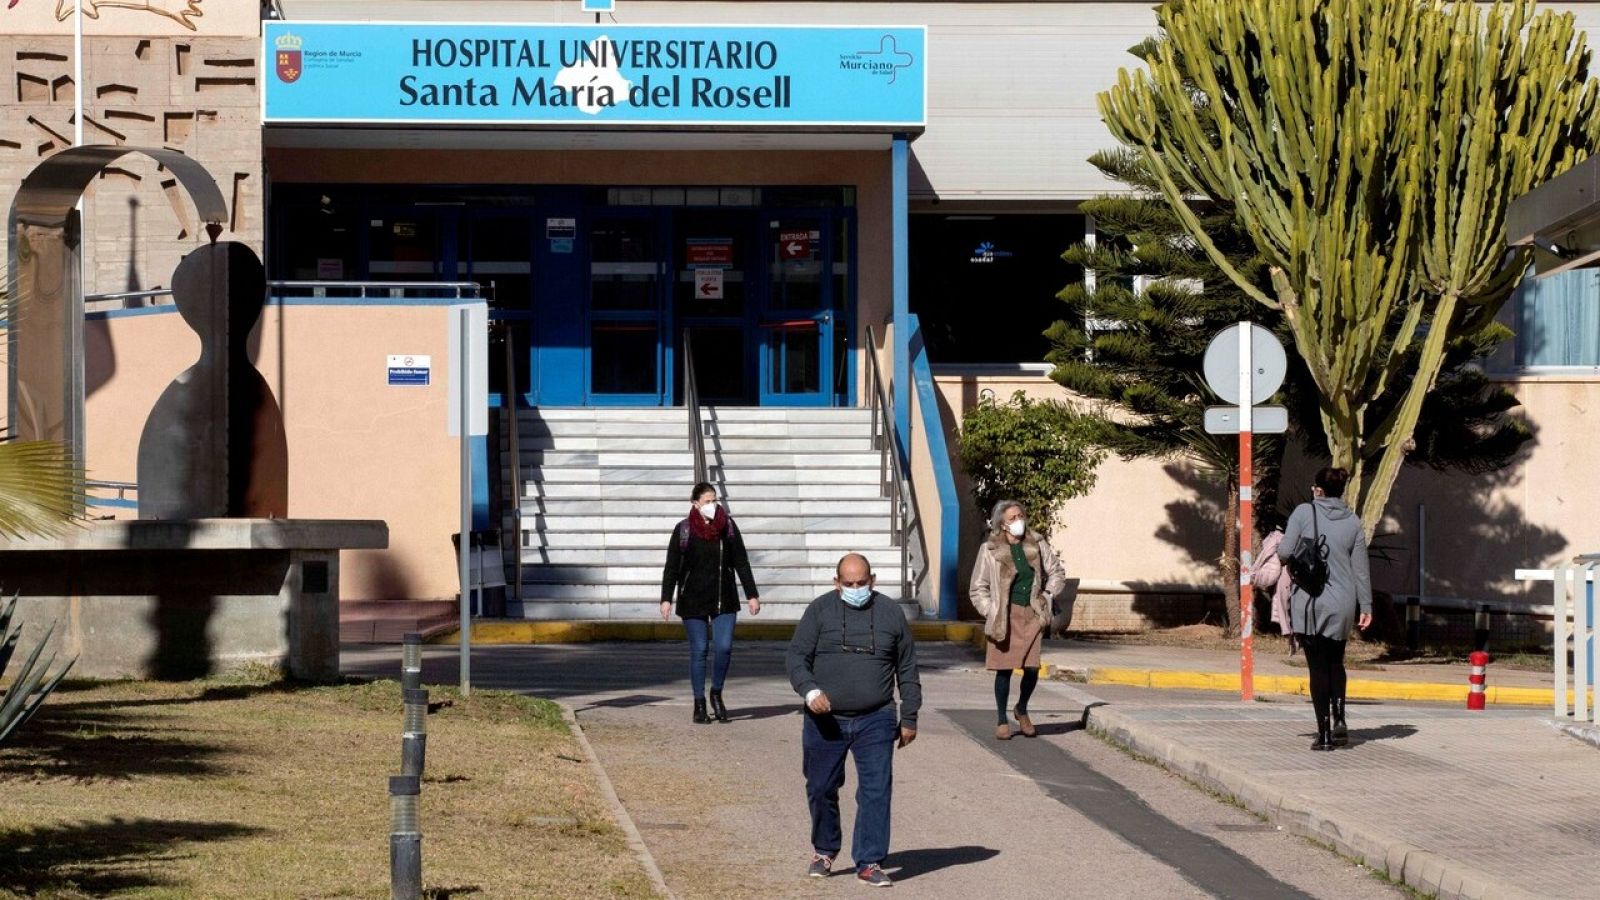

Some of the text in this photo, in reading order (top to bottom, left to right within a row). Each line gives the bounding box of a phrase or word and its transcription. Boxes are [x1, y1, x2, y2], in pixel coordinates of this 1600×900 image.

[413, 39, 777, 70] HOSPITAL UNIVERSITARIO
[840, 60, 893, 70] Murciano
[400, 75, 791, 108] Santa María del Rosell
[780, 232, 809, 241] ENTRADA
